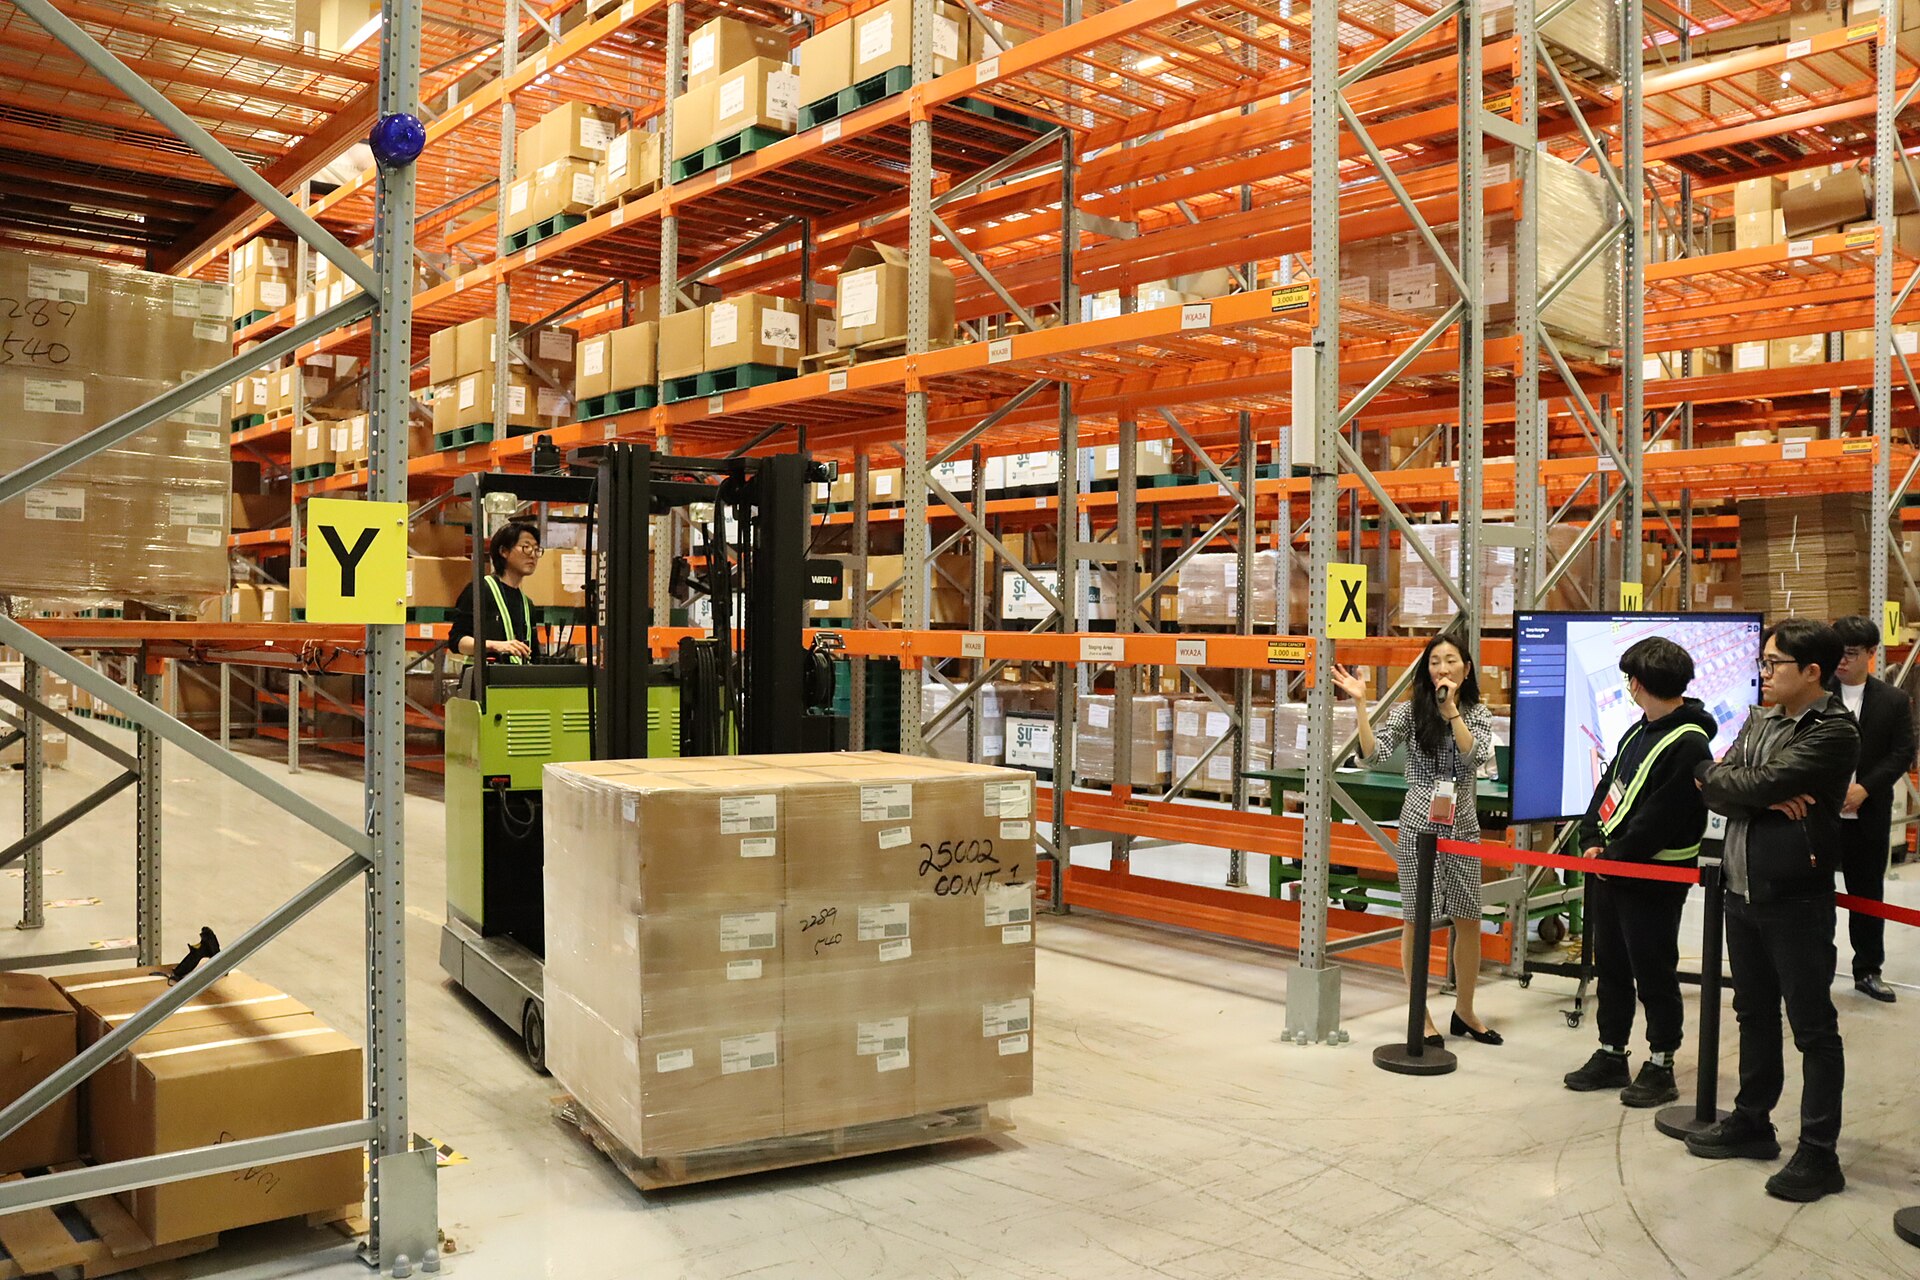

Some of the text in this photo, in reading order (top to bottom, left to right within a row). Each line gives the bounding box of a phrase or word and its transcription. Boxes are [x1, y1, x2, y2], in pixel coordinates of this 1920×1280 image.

[317, 525, 381, 597] Y
[598, 551, 607, 627] CLARK
[811, 575, 833, 585] WATA
[1338, 579, 1363, 623] X
[1888, 611, 1898, 636] V
[1179, 648, 1202, 657] WXA2A
[799, 907, 837, 932] 2289
